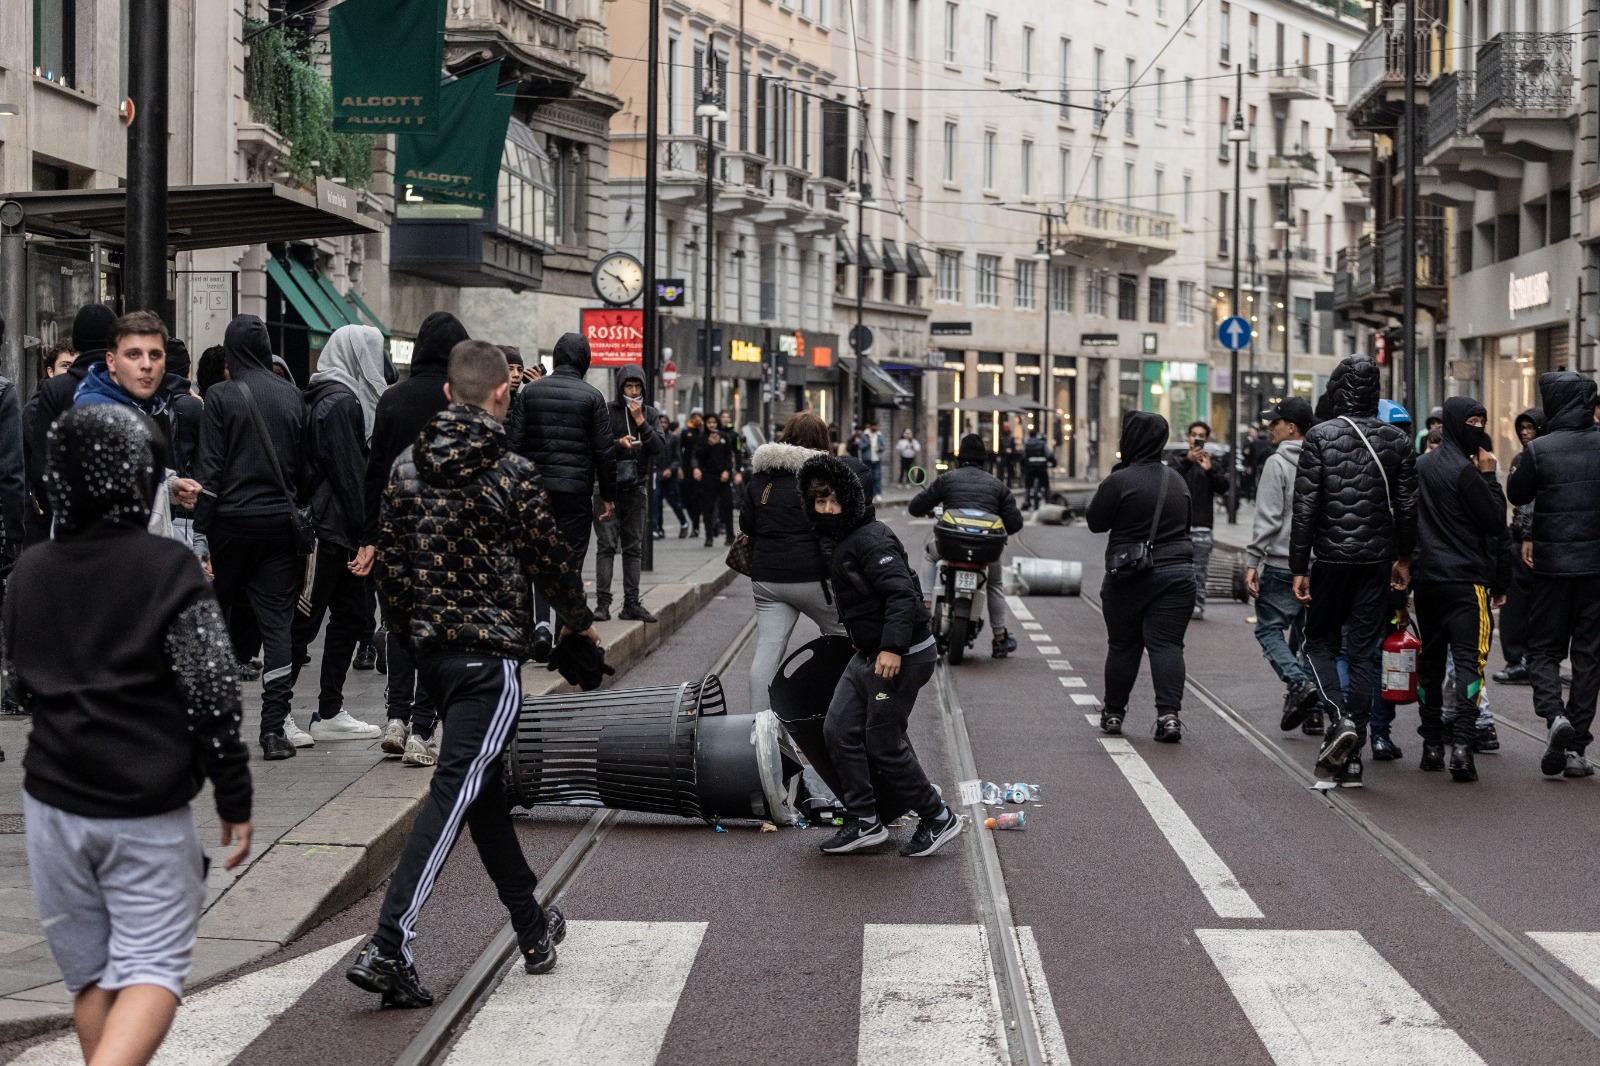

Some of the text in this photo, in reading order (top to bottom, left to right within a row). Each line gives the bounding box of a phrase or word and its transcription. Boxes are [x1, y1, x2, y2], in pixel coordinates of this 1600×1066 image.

[341, 96, 424, 107] ALCOTT
[405, 169, 472, 185] ALCOTT
[588, 325, 643, 340] ROSSIN
